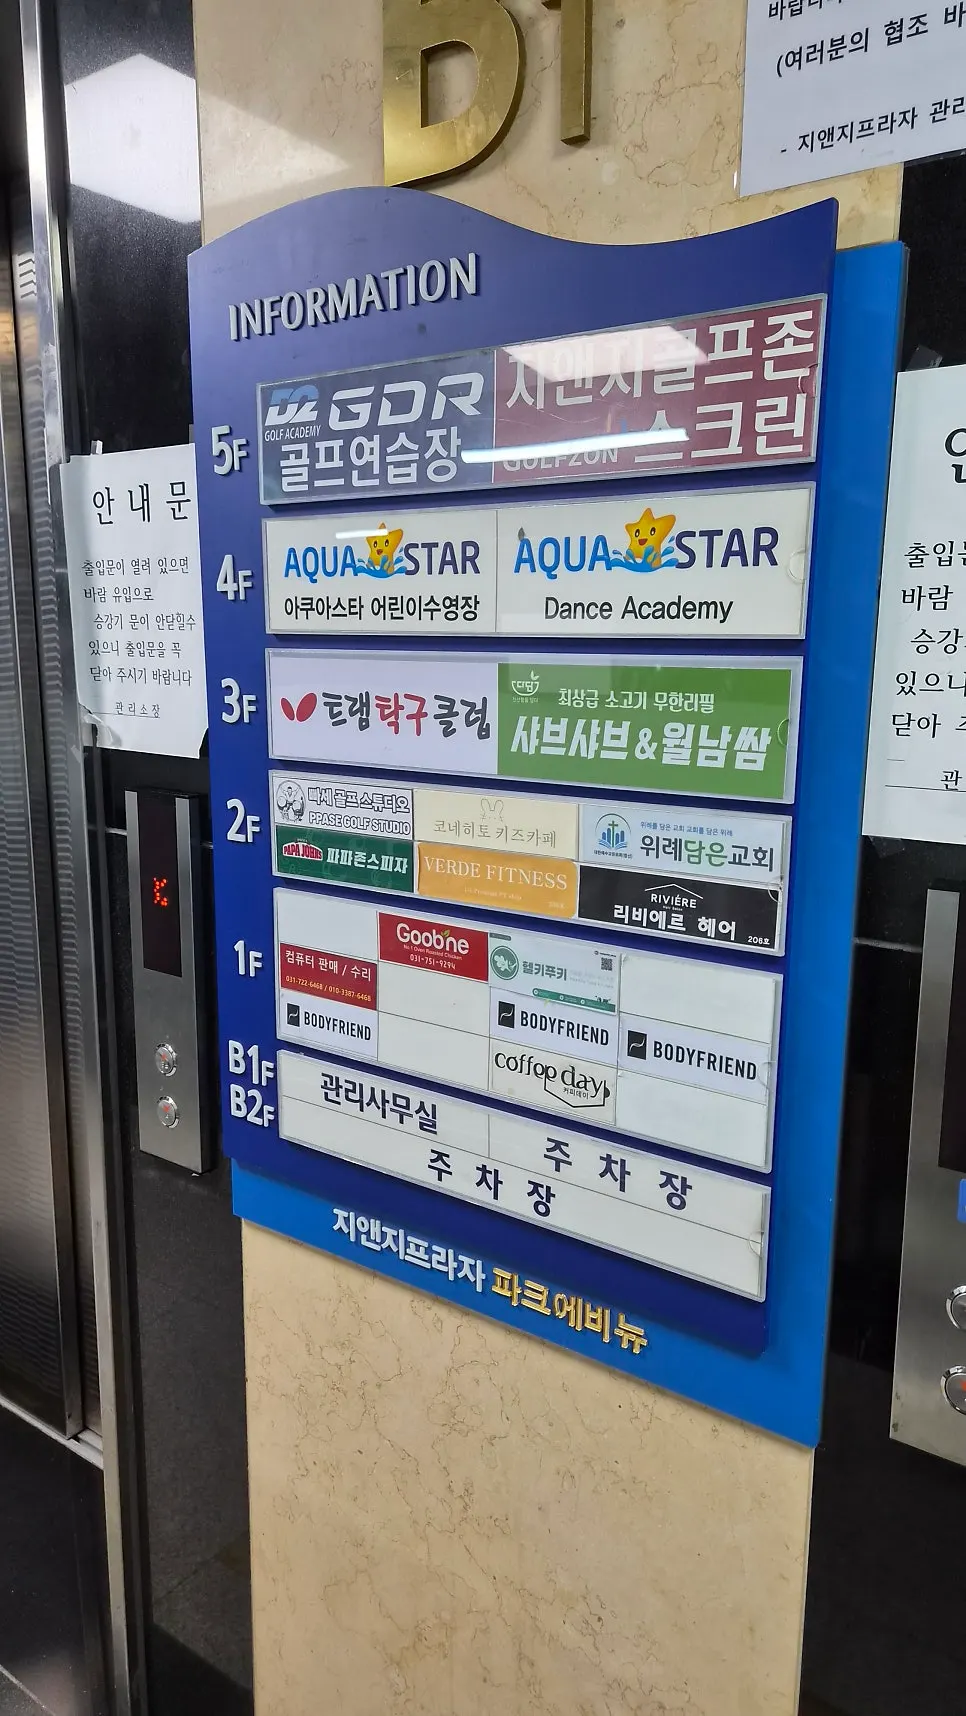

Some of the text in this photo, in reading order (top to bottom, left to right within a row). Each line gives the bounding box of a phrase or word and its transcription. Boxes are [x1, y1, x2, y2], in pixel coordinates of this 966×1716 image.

[776, 28, 869, 77] (여러분의
[884, 13, 929, 46] 협조
[798, 106, 918, 153] 지앤지프라자
[228, 252, 478, 342] INFORMATION
[506, 310, 814, 411] 지앤지골프존
[328, 372, 485, 432] GDR
[264, 425, 321, 441] GOLF ACADEMY
[634, 393, 808, 463] 스크린
[211, 425, 249, 475] 5F
[279, 425, 463, 493] 골프연습장
[82, 556, 189, 577] 출입문이 열려 있으면
[284, 540, 481, 584] AQUA STAR
[514, 526, 779, 579] AQUA STAR
[83, 586, 154, 603] 바람 유입으로
[216, 554, 254, 600] 4F
[284, 594, 480, 622] 아쿠아스타 어린이수영장
[544, 595, 734, 624] Dance Academy
[901, 584, 953, 611] 바람
[94, 613, 123, 630] 승강기
[129, 613, 149, 630] 문이
[88, 639, 181, 659] 있으니 출입문을 꼭
[910, 628, 966, 655] 승강
[90, 665, 111, 682] 닫아
[116, 667, 147, 684] 주시기
[221, 677, 257, 724] 3F
[558, 688, 715, 714] 최상급 소고기 무한리필
[892, 712, 941, 739] 닫아
[308, 787, 410, 813] 빠세 골프 스튜디오
[226, 798, 261, 843] 2F
[309, 811, 411, 835] PPASE GOLF STUDIO
[433, 820, 556, 848] 코네히토 키즈카페
[326, 847, 408, 874] 파파존스피자
[640, 835, 774, 872] 위례담은교회
[424, 856, 567, 890] VERDE FITNESS
[613, 904, 736, 941] 리비에르 헤어
[747, 935, 770, 945] 206호
[233, 940, 263, 978] 1F
[285, 949, 314, 969] 컴퓨터
[318, 956, 338, 975] 판매
[350, 964, 371, 982] 수리
[304, 1011, 371, 1041] BODYFRIEND
[520, 1010, 609, 1046] BODYFRIEND
[228, 1039, 275, 1086] B1F
[653, 1040, 757, 1081] BODYFRIEND
[560, 1065, 603, 1098] day
[563, 1087, 589, 1099] 커피데이
[229, 1084, 275, 1128] B2F
[320, 1072, 438, 1135] 관리사무실
[332, 1207, 648, 1355] 지앤지프라자 파크에비뉴
